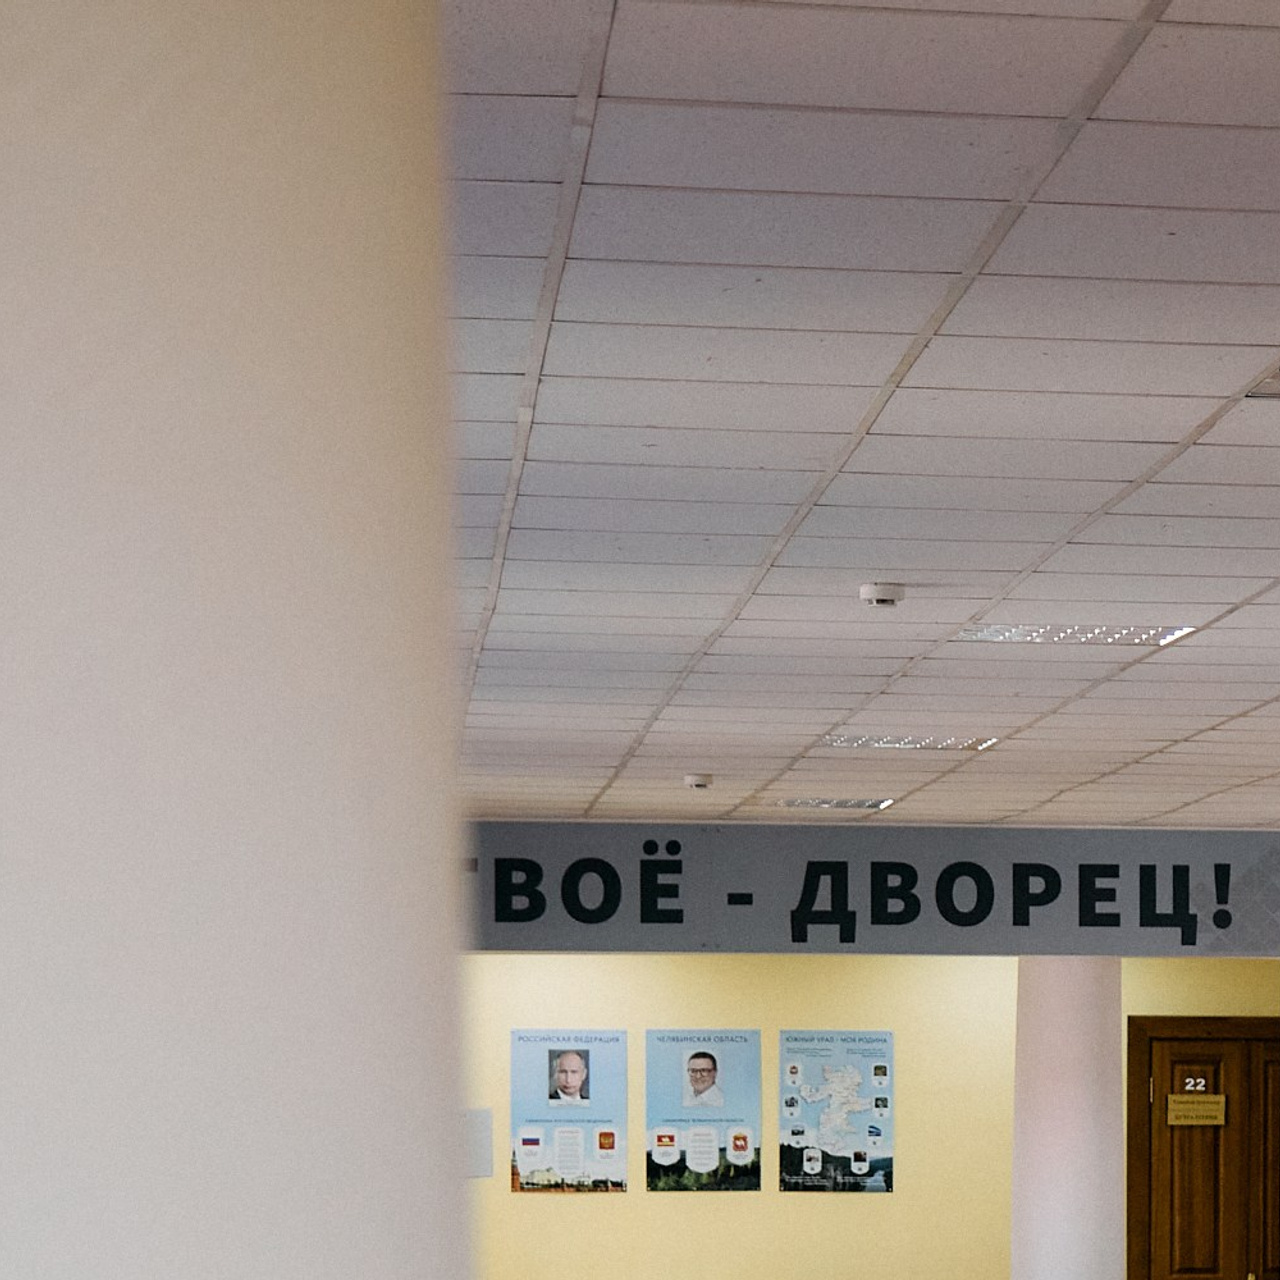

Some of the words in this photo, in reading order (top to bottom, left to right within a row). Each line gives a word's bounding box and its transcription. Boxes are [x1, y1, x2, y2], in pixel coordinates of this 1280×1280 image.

[466, 839, 684, 925] ВОЁ
[726, 892, 754, 907] -
[790, 860, 1234, 946] ДВОРЕЦ!
[1184, 1077, 1206, 1091] 22
